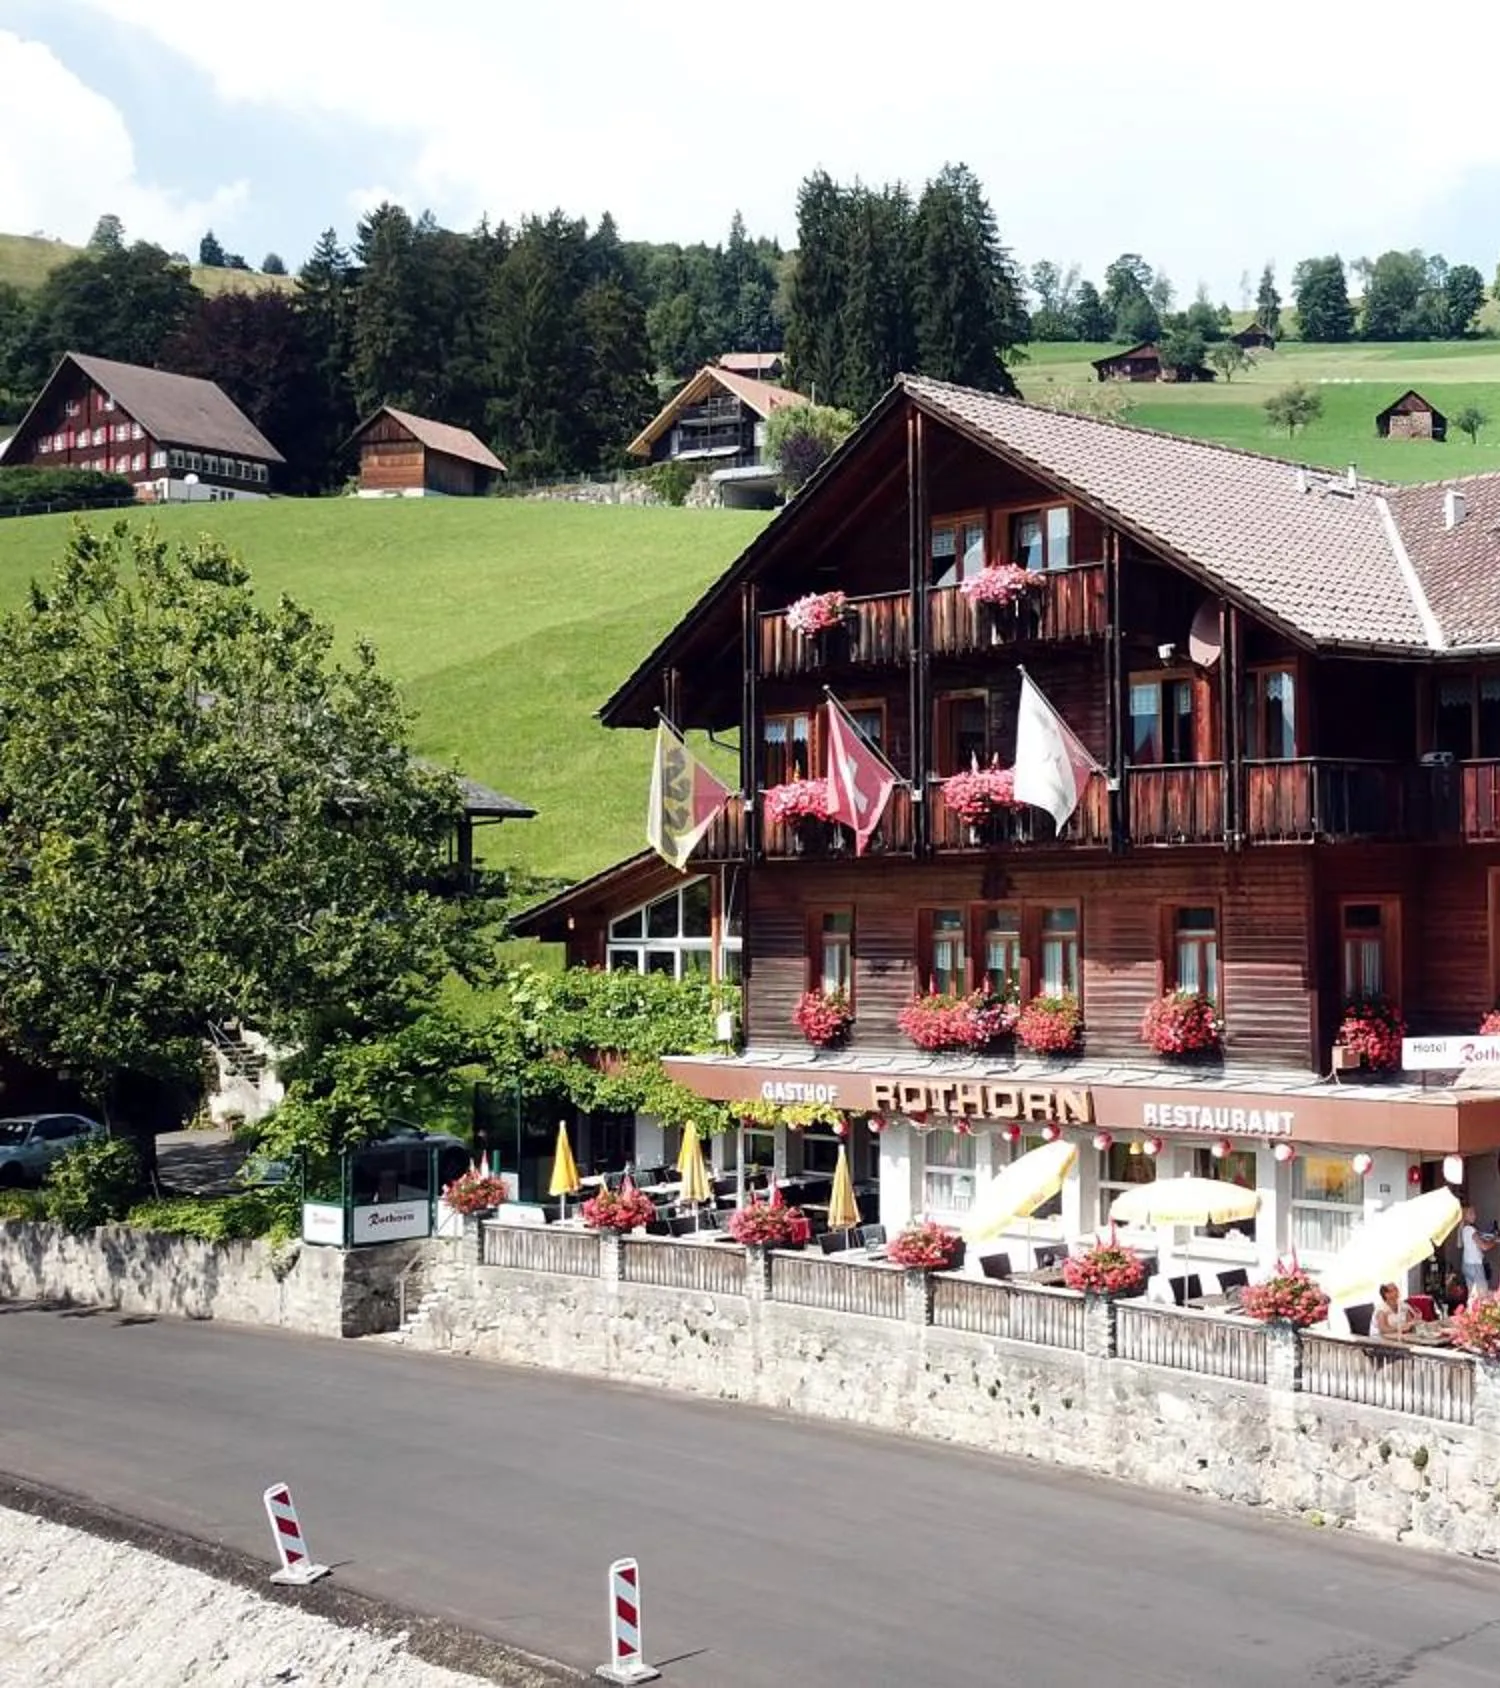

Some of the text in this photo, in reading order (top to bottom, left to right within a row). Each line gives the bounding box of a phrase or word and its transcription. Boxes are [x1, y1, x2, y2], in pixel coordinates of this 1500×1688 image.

[1412, 1041, 1447, 1053] Hotel
[762, 1078, 1294, 1134] GASTHOF ROTHORN RESTAURANT
